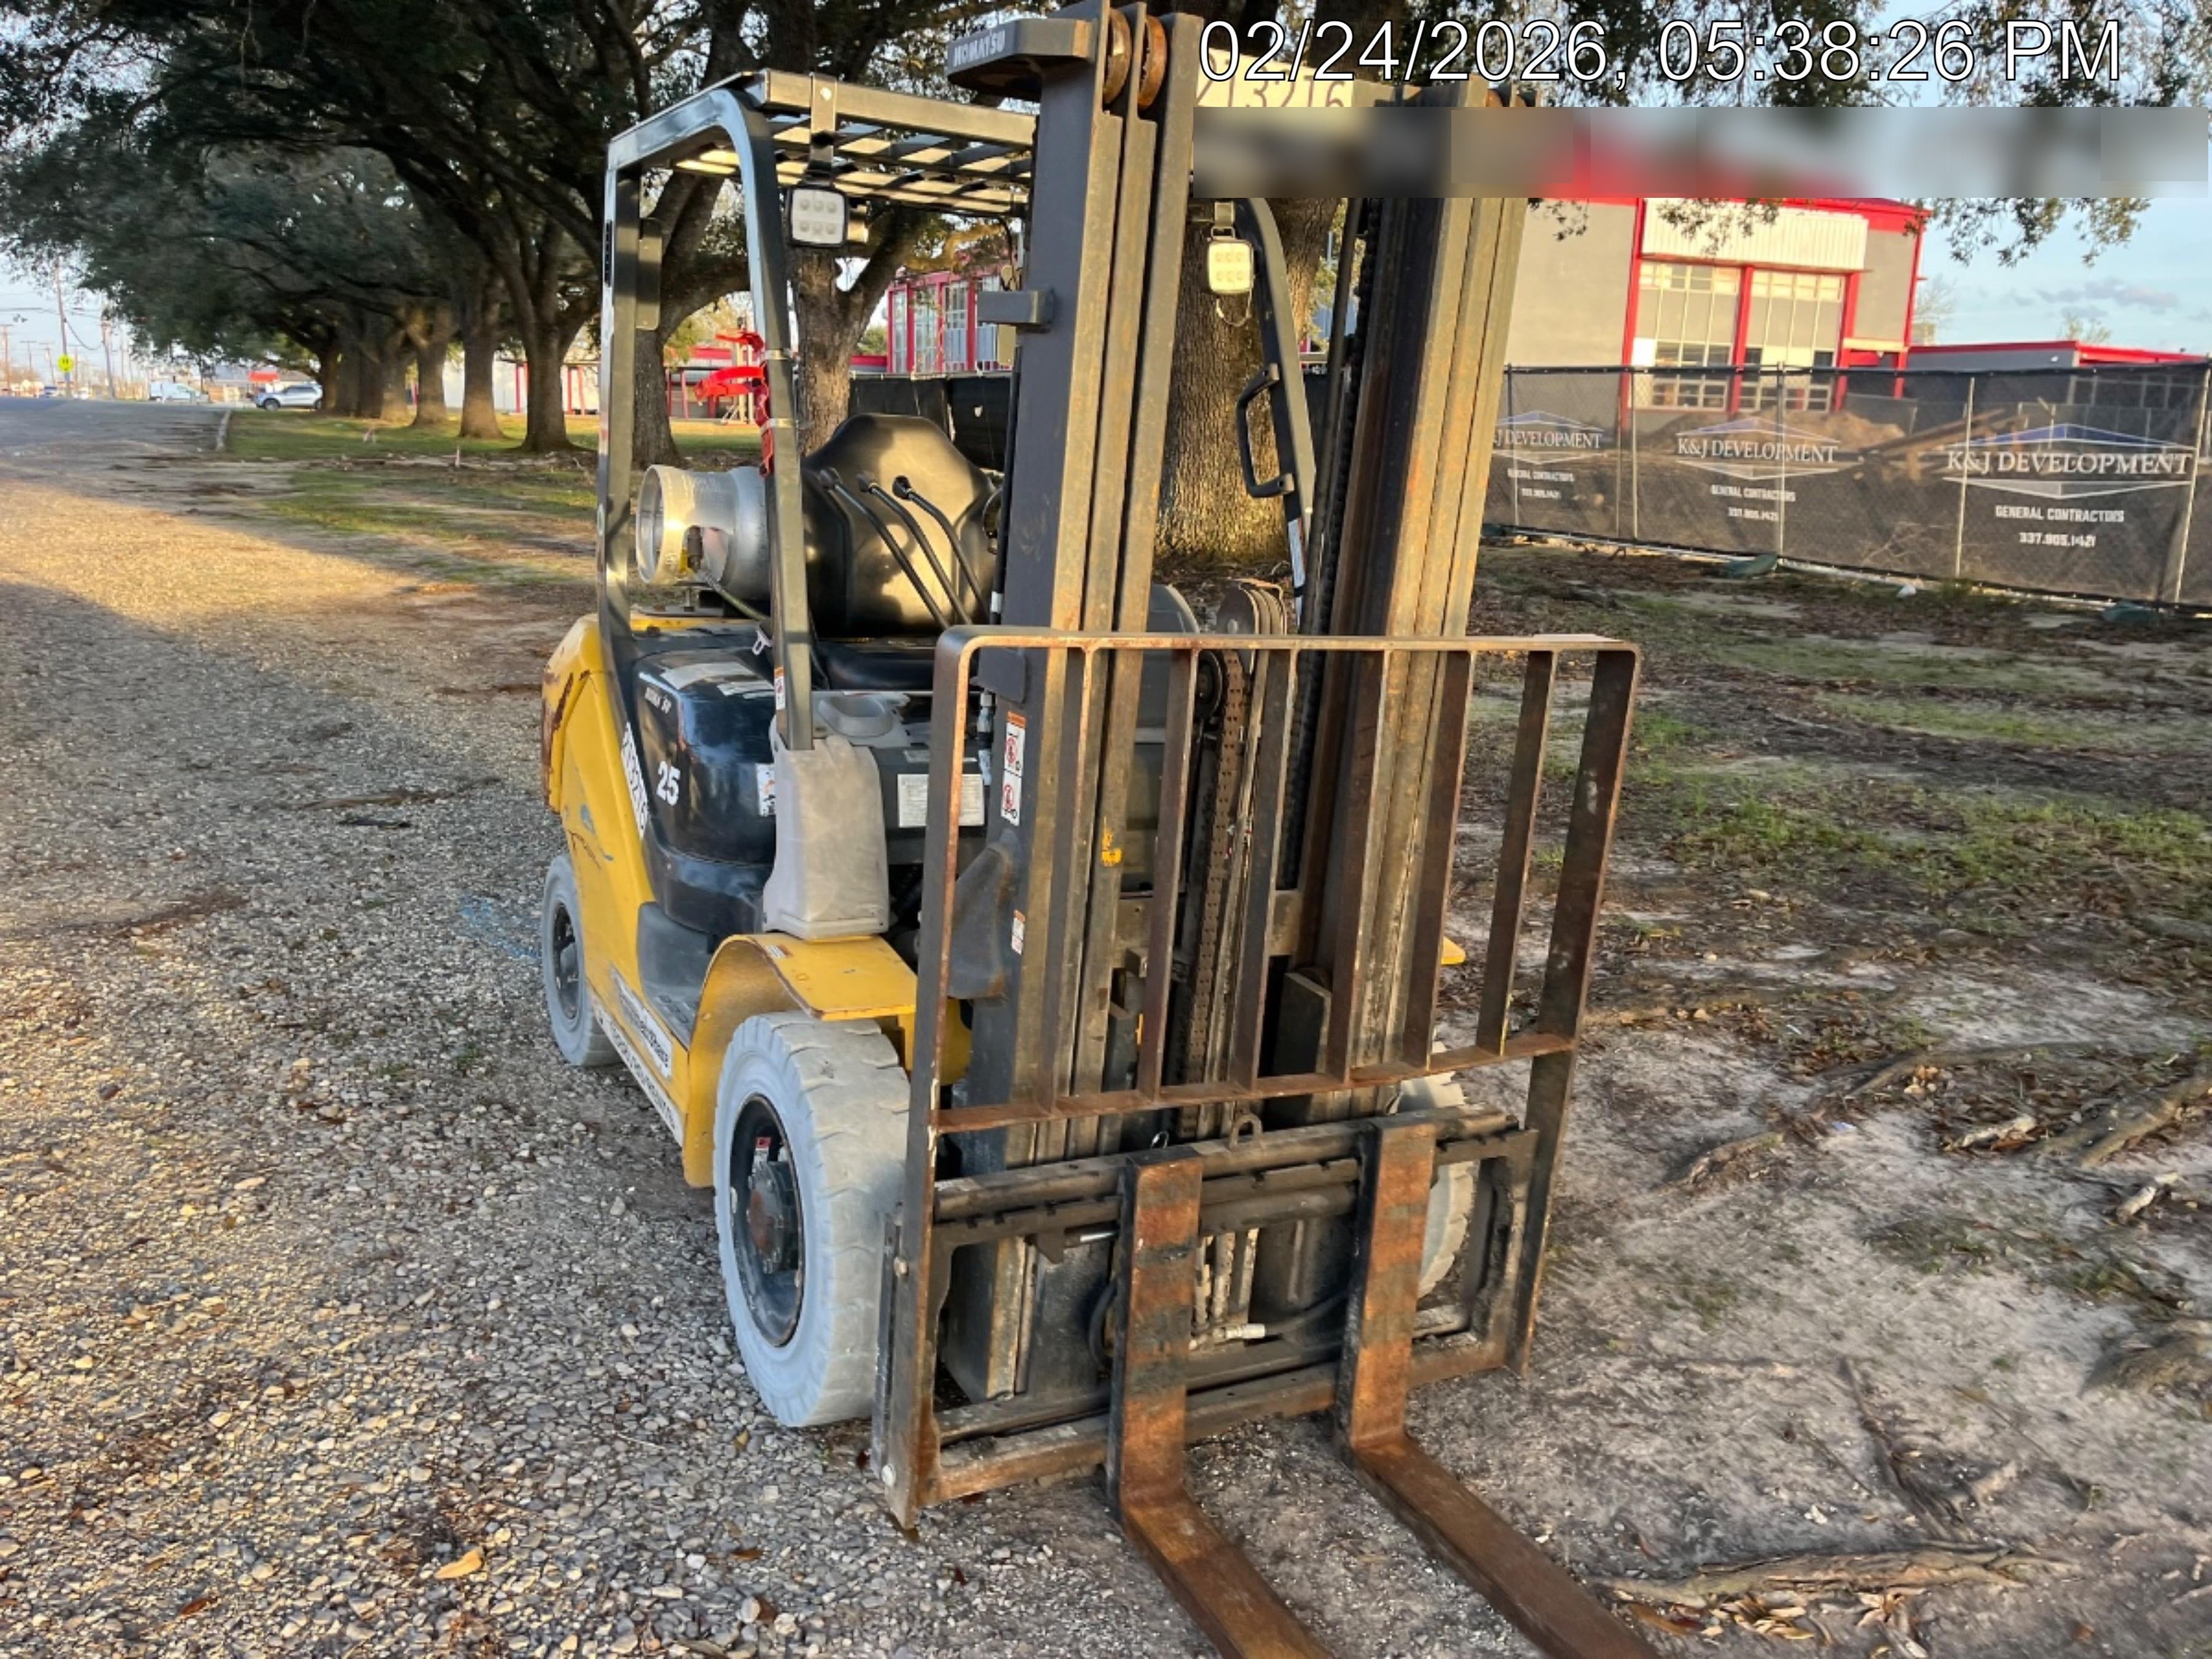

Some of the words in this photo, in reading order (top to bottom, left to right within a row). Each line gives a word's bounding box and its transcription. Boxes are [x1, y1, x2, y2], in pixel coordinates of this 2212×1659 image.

[1505, 429, 1602, 449] DEVELOPMENT
[1677, 437, 1708, 459] K&J
[1711, 439, 1838, 463] DEVELOPMENT
[1947, 450, 1991, 475] K&J
[1998, 452, 2192, 475] DEVELOPMENT
[1995, 505, 2044, 520] GENERAL
[2047, 508, 2124, 523] CONTRACTORS
[656, 760, 681, 806] 25
